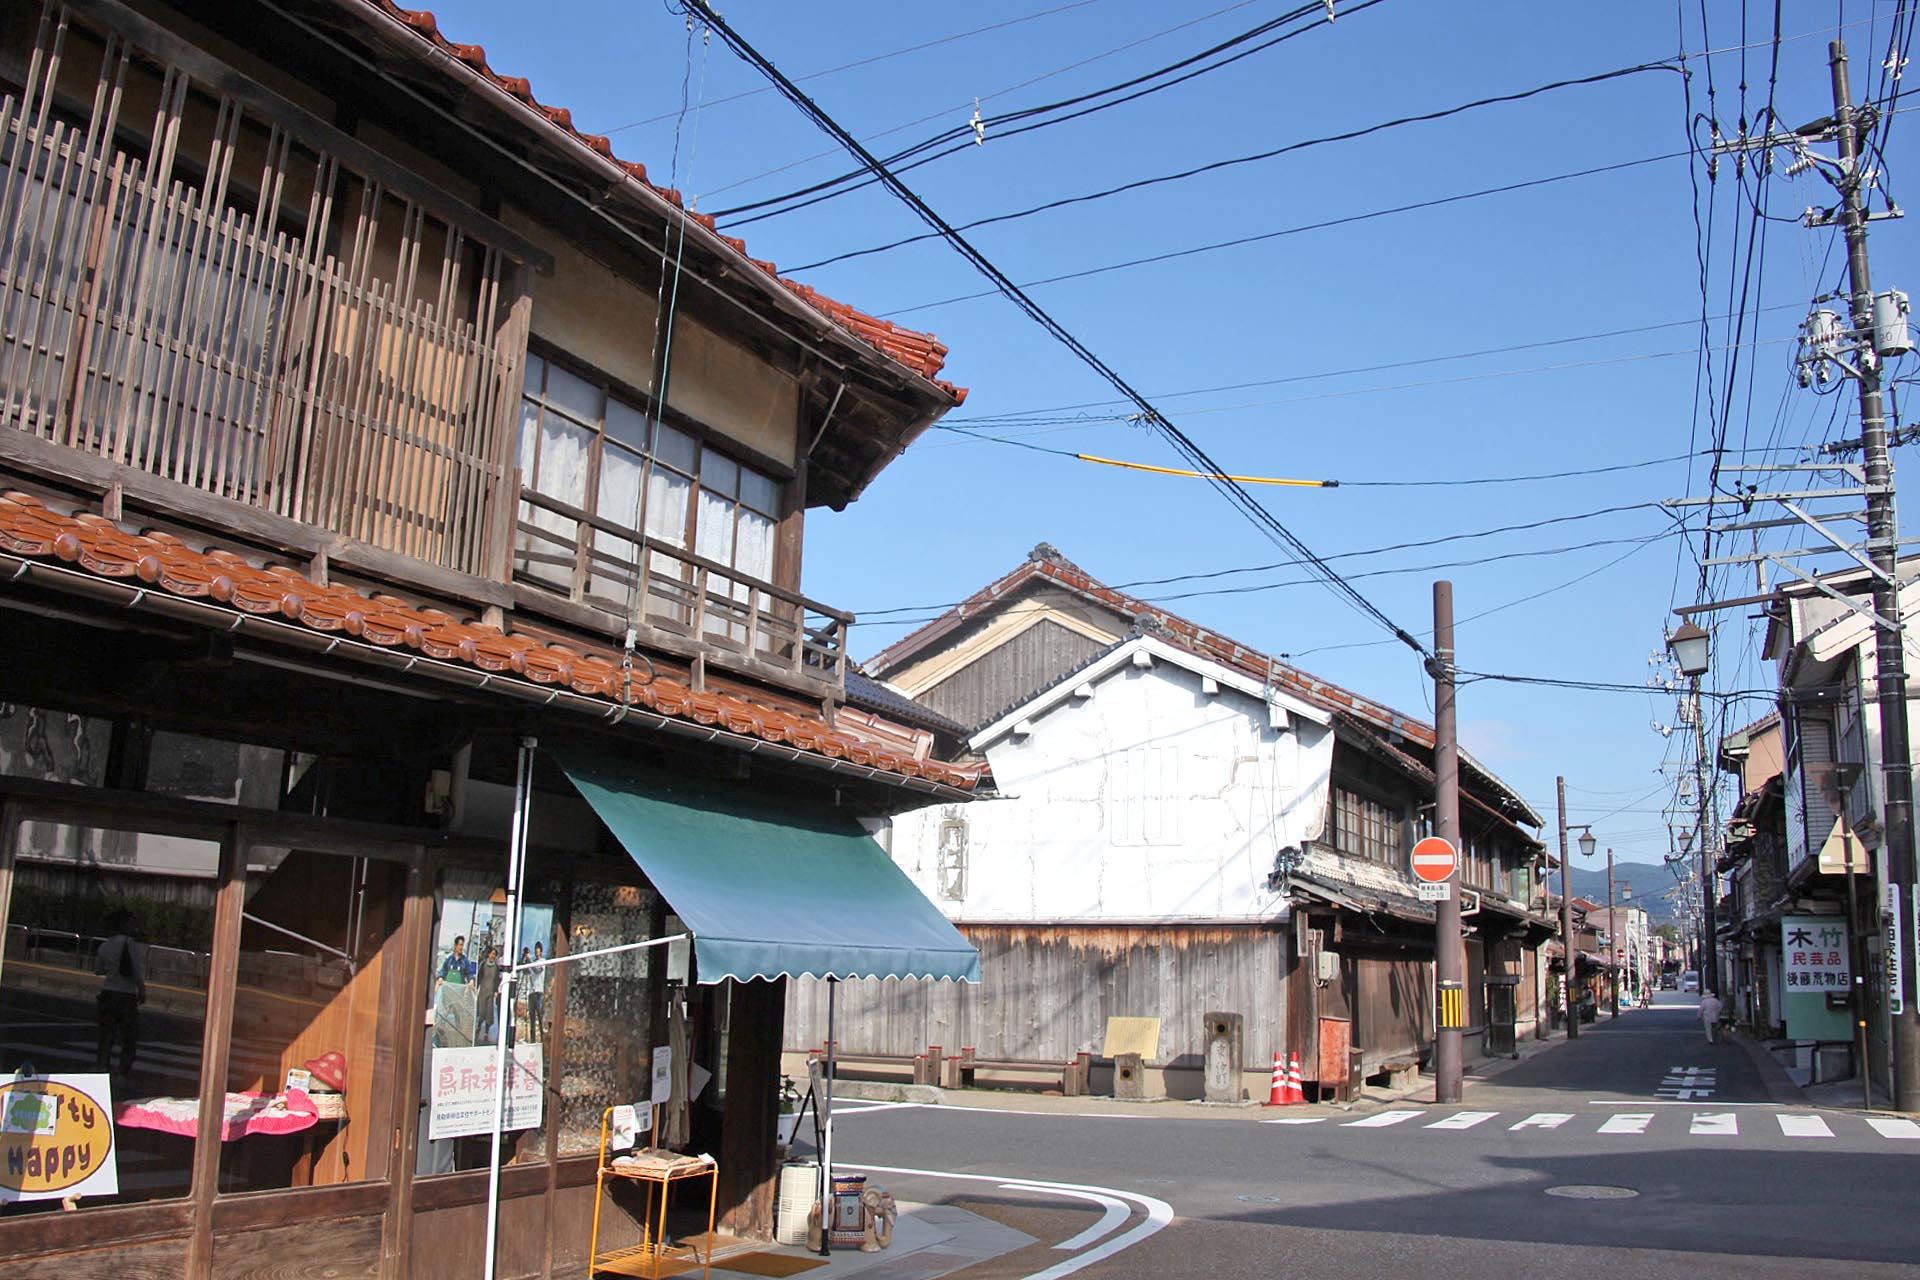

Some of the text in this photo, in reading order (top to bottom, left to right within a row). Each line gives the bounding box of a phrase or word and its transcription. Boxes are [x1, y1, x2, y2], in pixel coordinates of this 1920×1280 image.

[1792, 951, 1841, 965] 民芸品
[1787, 971, 1848, 986] 後藤荒物店
[8, 1142, 91, 1183] Happy
